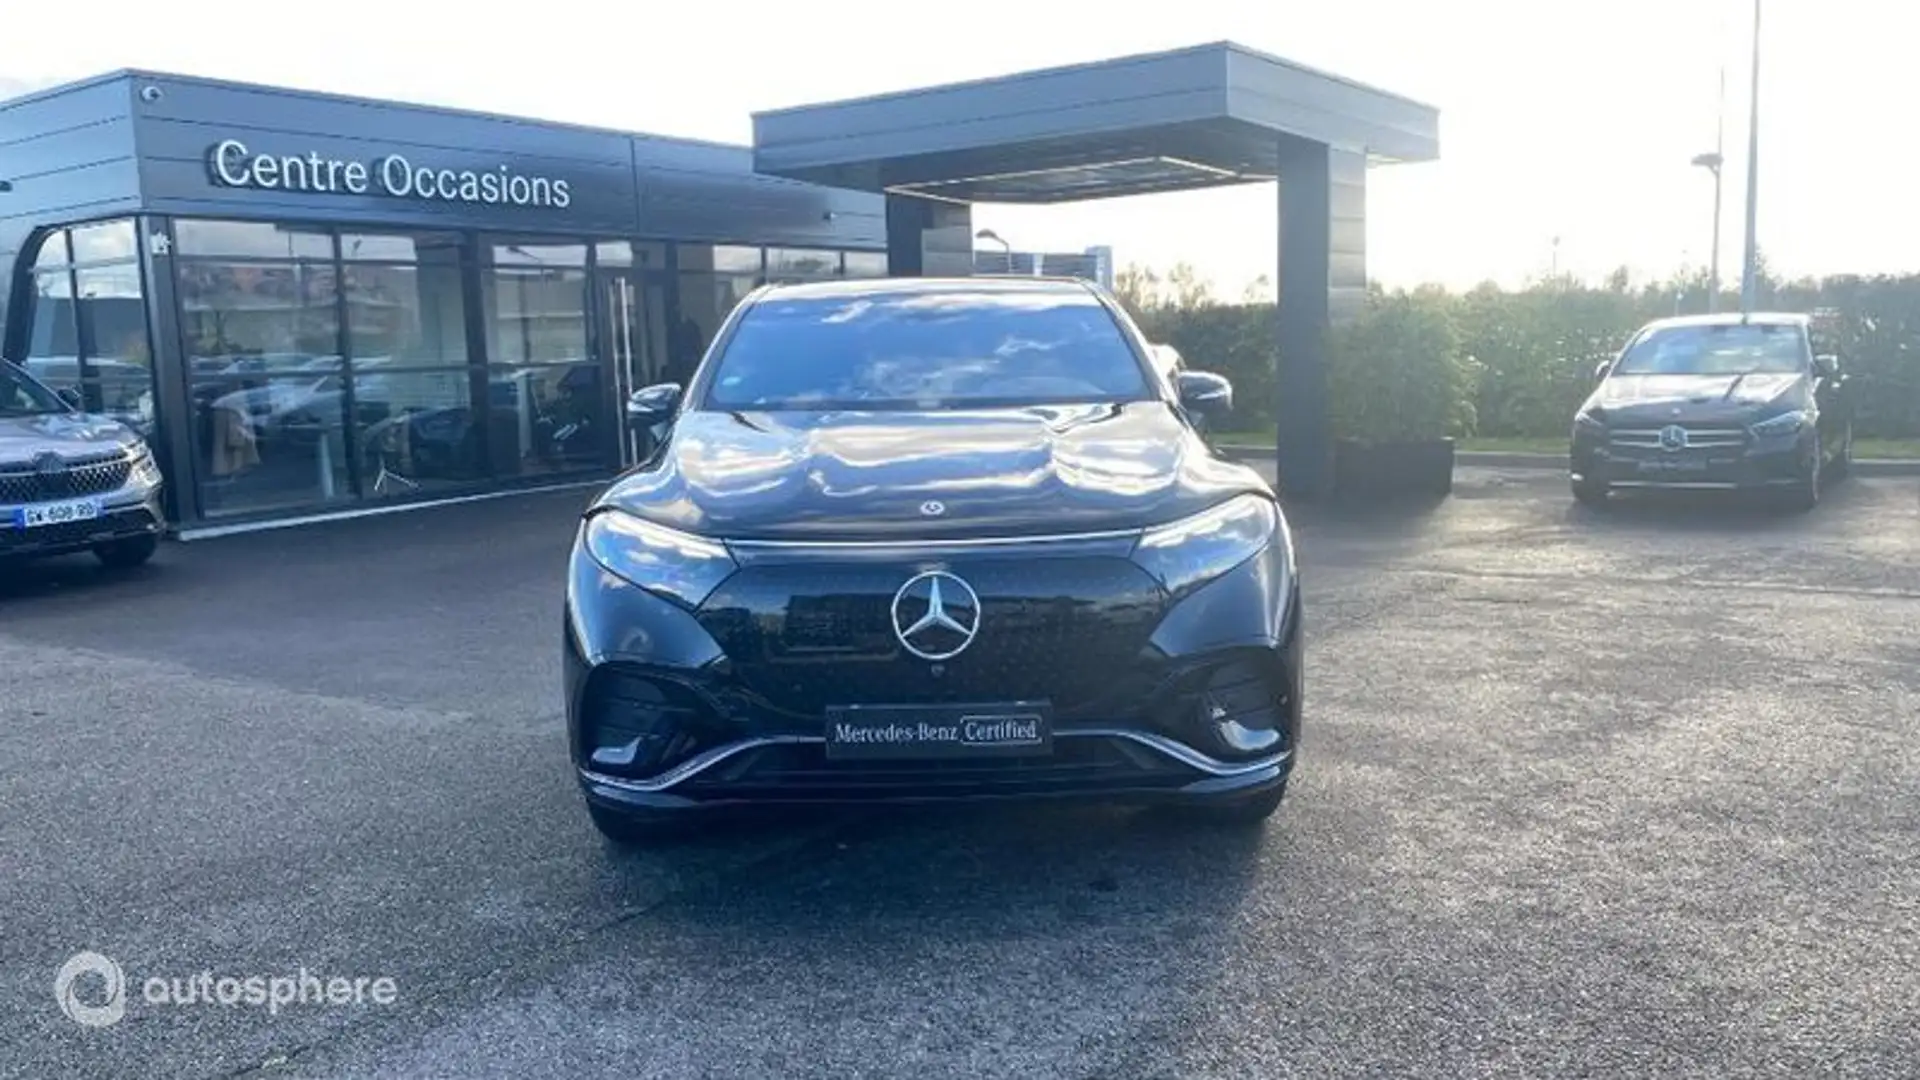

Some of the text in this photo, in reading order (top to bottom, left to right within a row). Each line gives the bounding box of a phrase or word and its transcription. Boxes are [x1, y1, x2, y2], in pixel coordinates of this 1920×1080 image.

[213, 139, 571, 209] Centre Occasions
[834, 719, 1036, 744] Mercedes-Benz Certified
